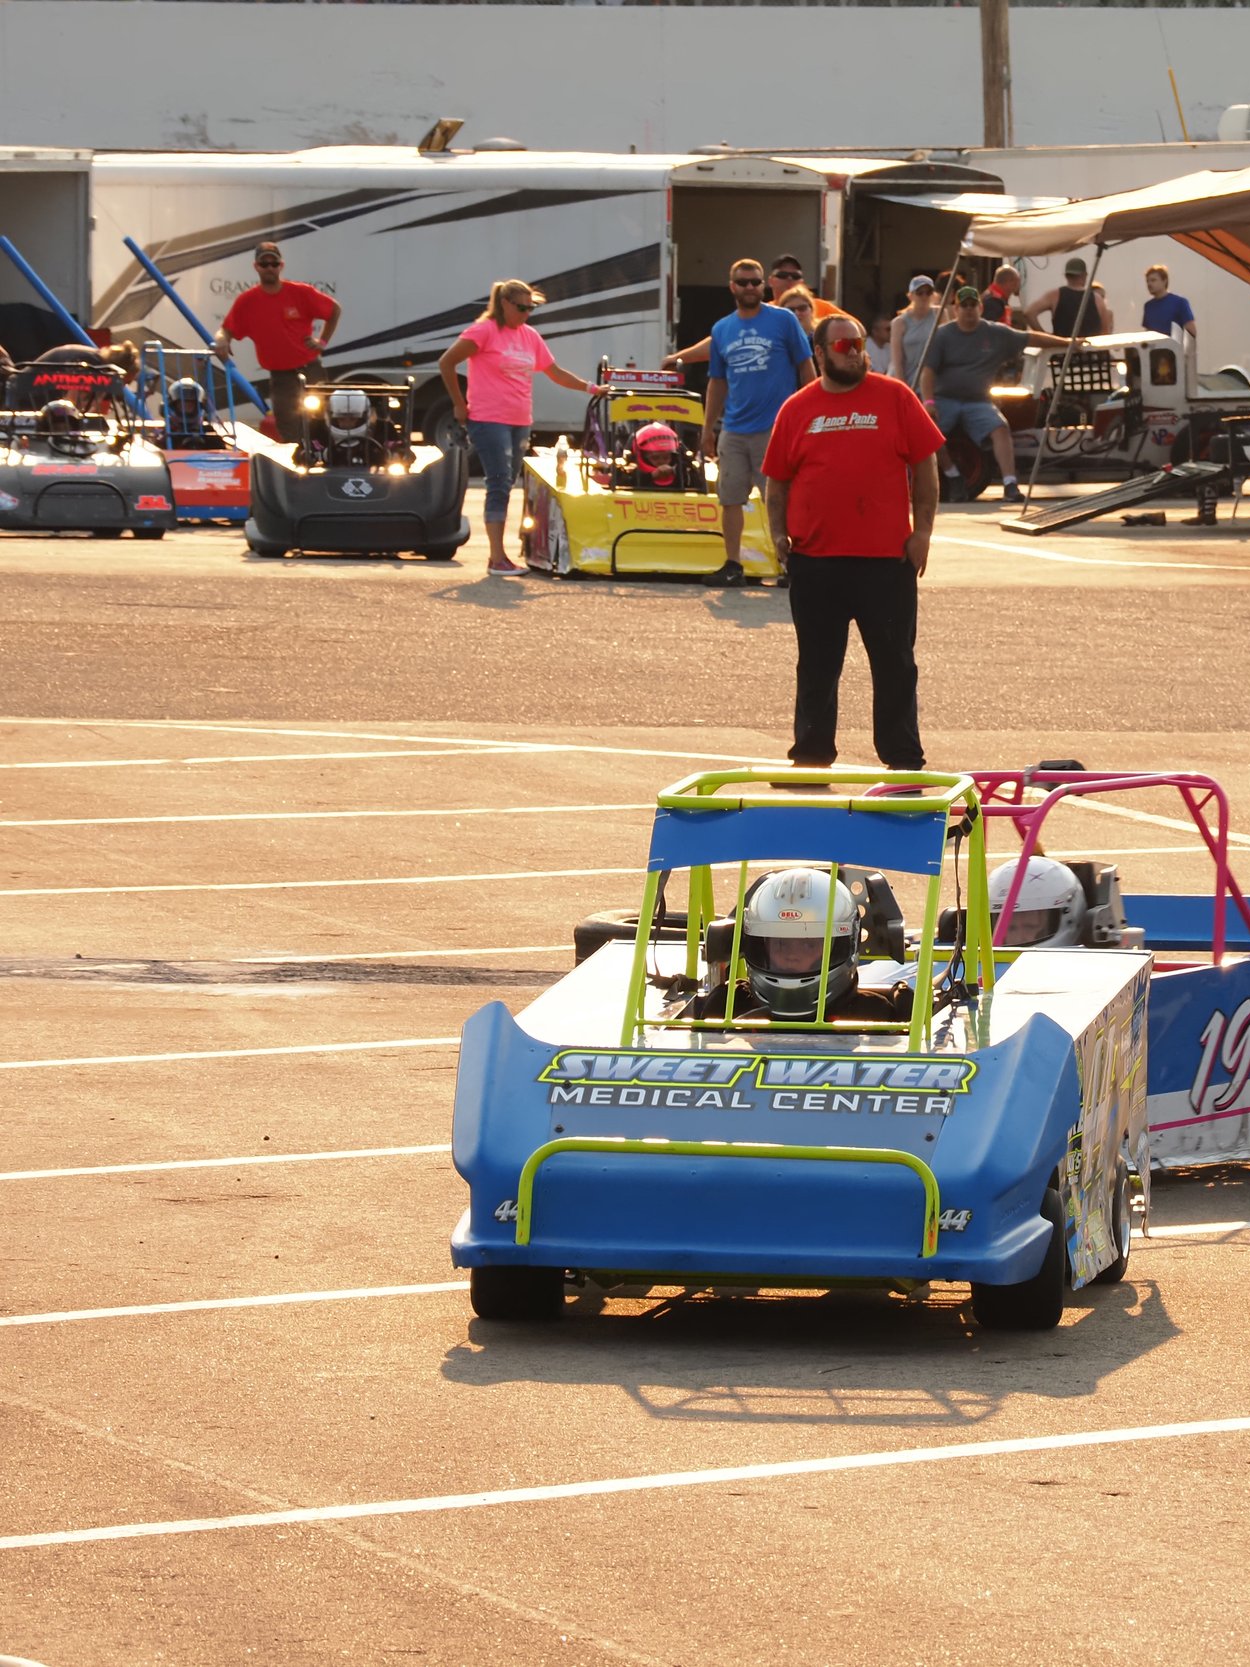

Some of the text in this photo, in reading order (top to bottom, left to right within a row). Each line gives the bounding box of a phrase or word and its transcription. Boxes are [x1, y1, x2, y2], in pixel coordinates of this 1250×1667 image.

[614, 499, 718, 523] TWISTED
[551, 1054, 967, 1089] SWEET WATER
[551, 1087, 952, 1115] MEDICAL CENTER
